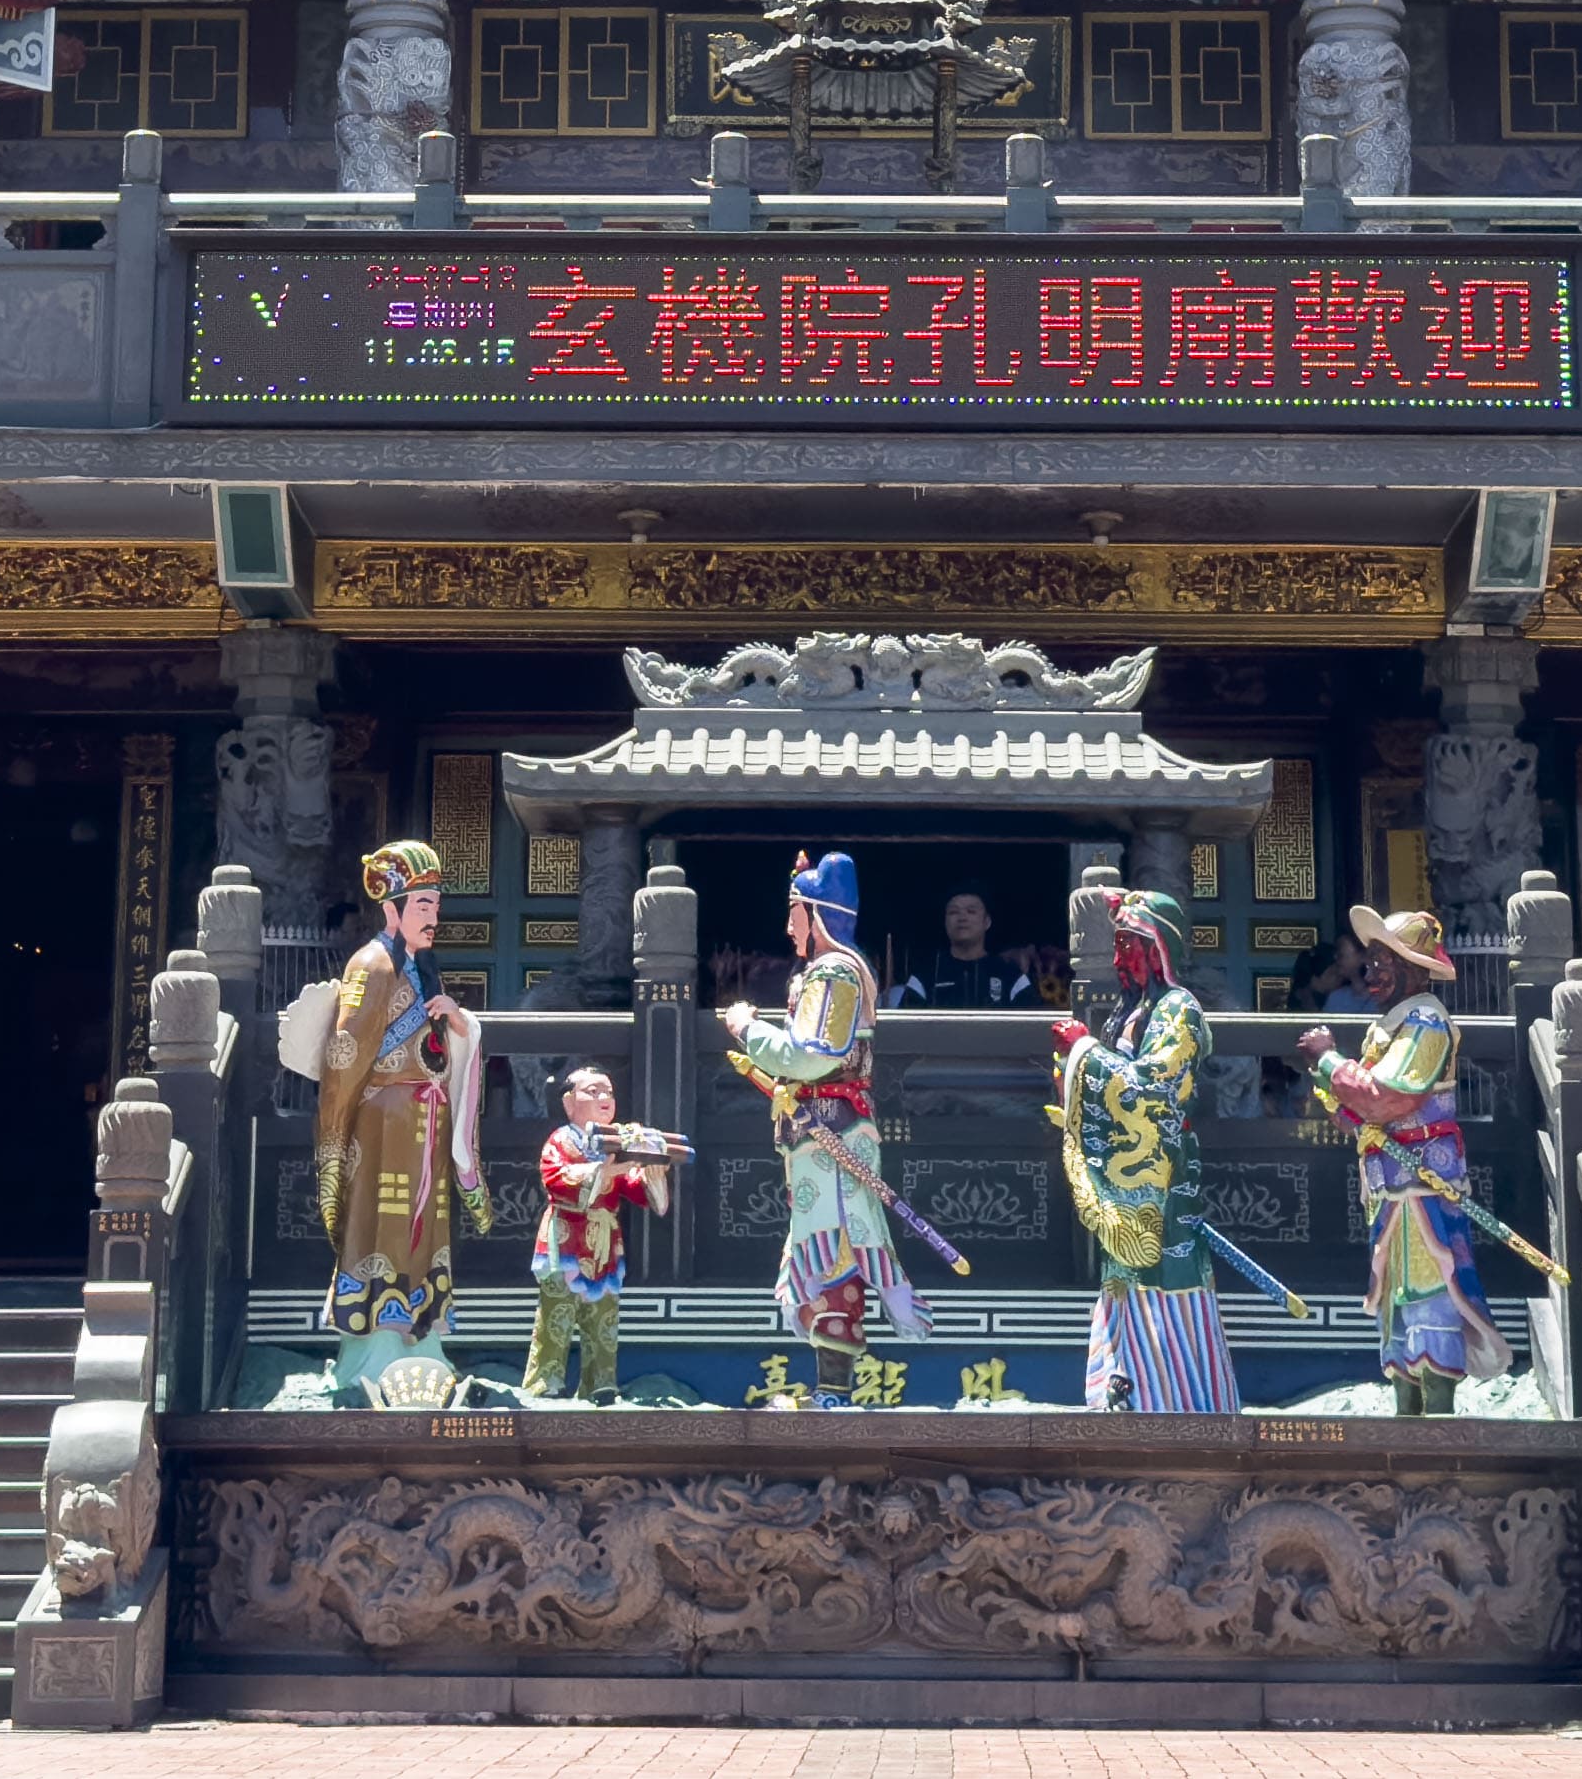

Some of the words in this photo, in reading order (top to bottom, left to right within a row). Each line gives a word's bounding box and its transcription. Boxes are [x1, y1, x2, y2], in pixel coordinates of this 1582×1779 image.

[527, 267, 1539, 386] 玄機院孔明廟歡迎
